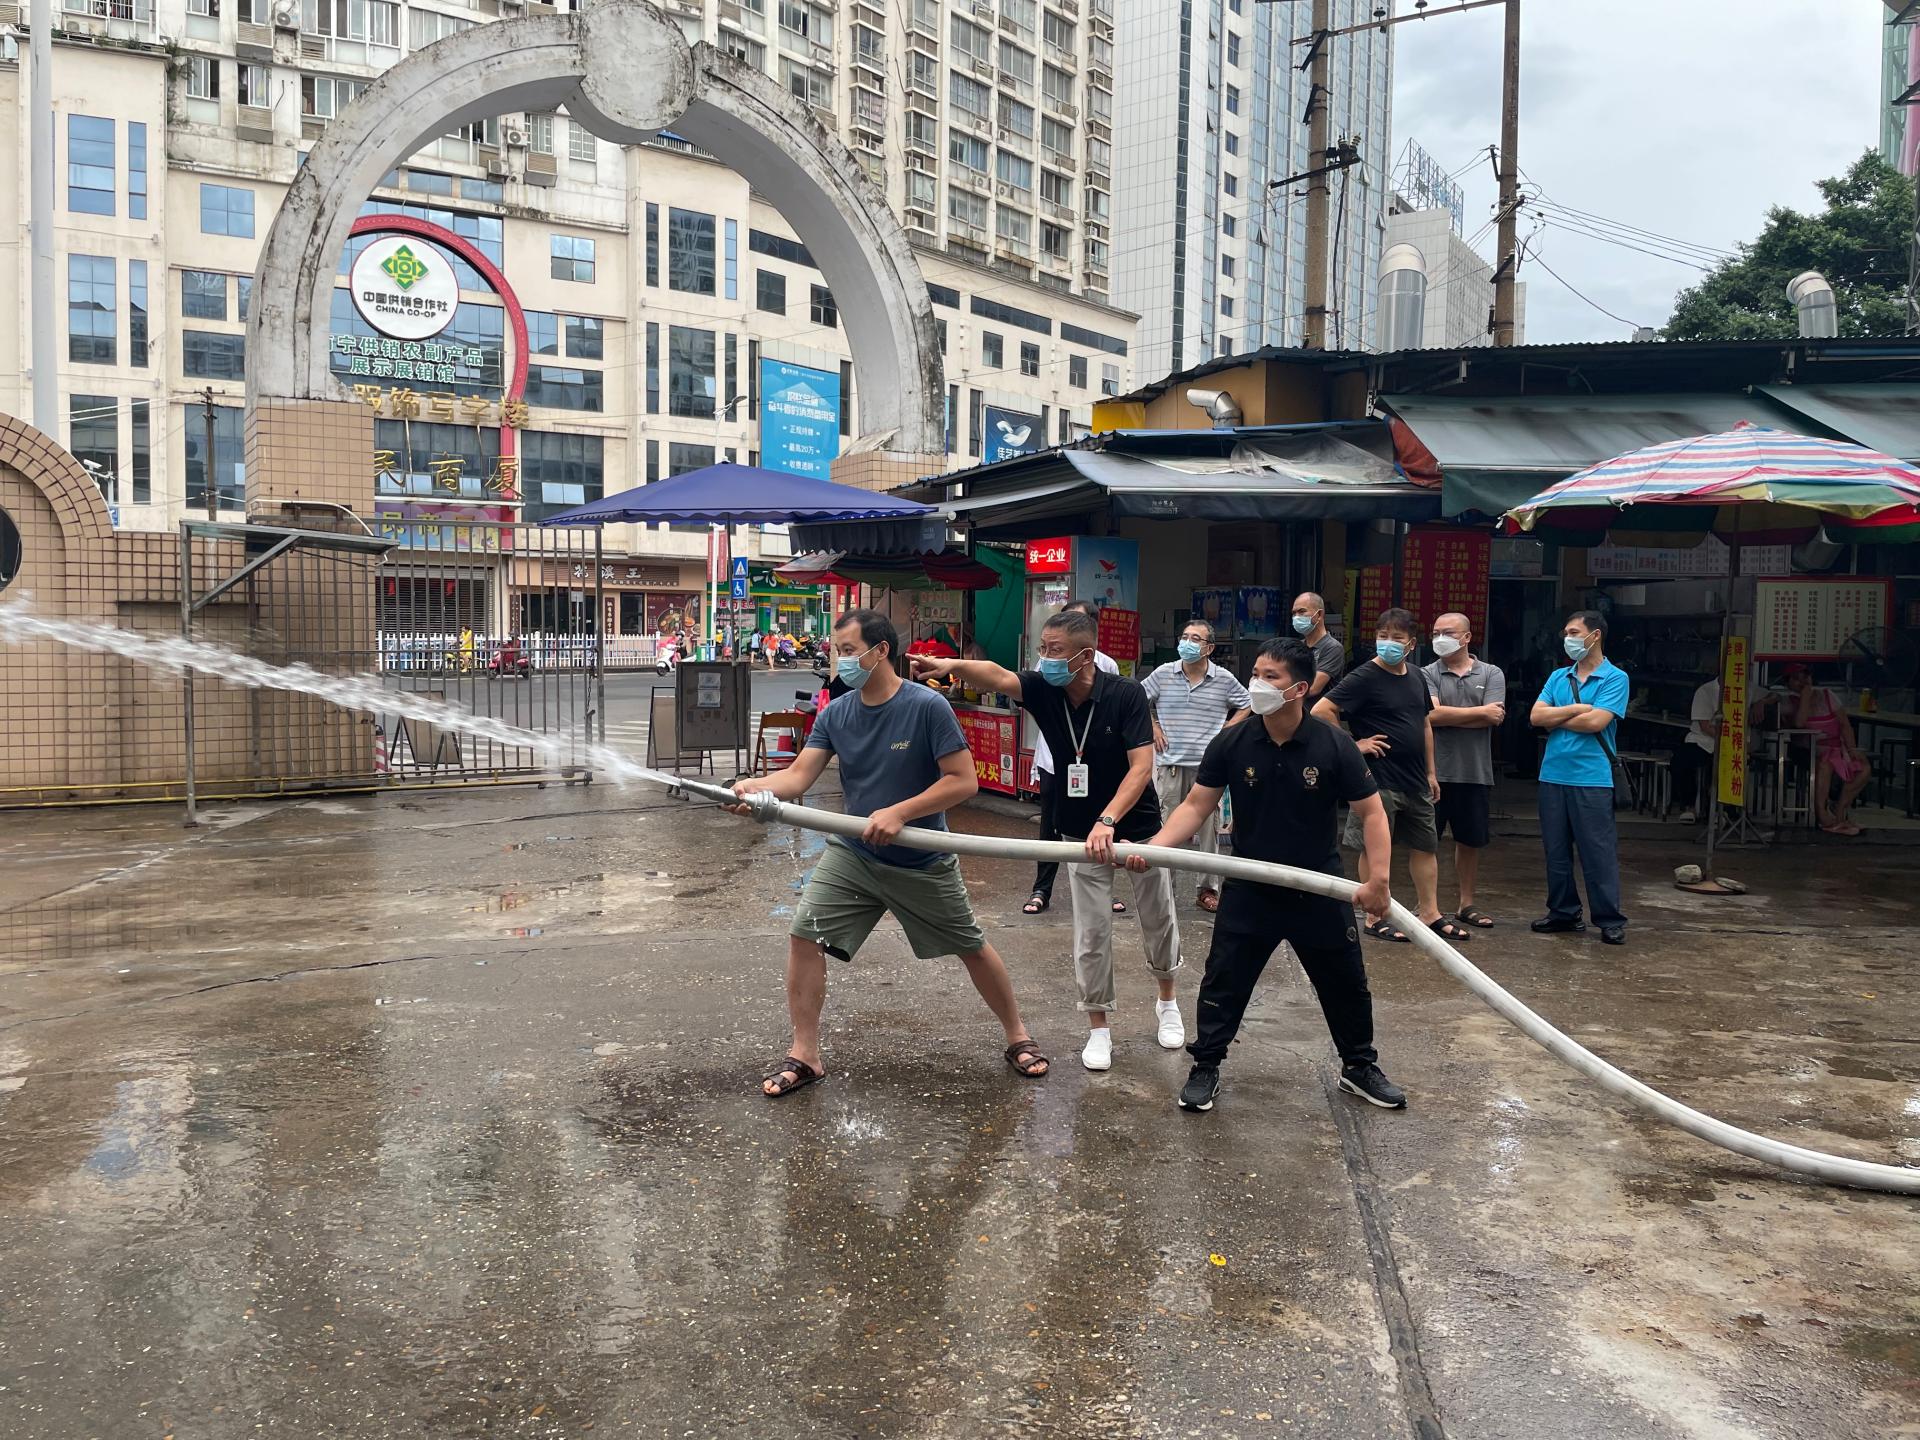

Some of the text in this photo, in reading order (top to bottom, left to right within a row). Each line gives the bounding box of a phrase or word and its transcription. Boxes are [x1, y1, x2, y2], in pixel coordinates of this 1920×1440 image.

[363, 291, 448, 312] 中国供销合作社
[375, 305, 436, 318] CHINA CO-OP
[329, 335, 484, 367] 宁供销农副产品
[351, 356, 456, 383] 展示展销馆
[353, 383, 529, 429] 服饰写字楼
[1029, 547, 1066, 564] 统一企业
